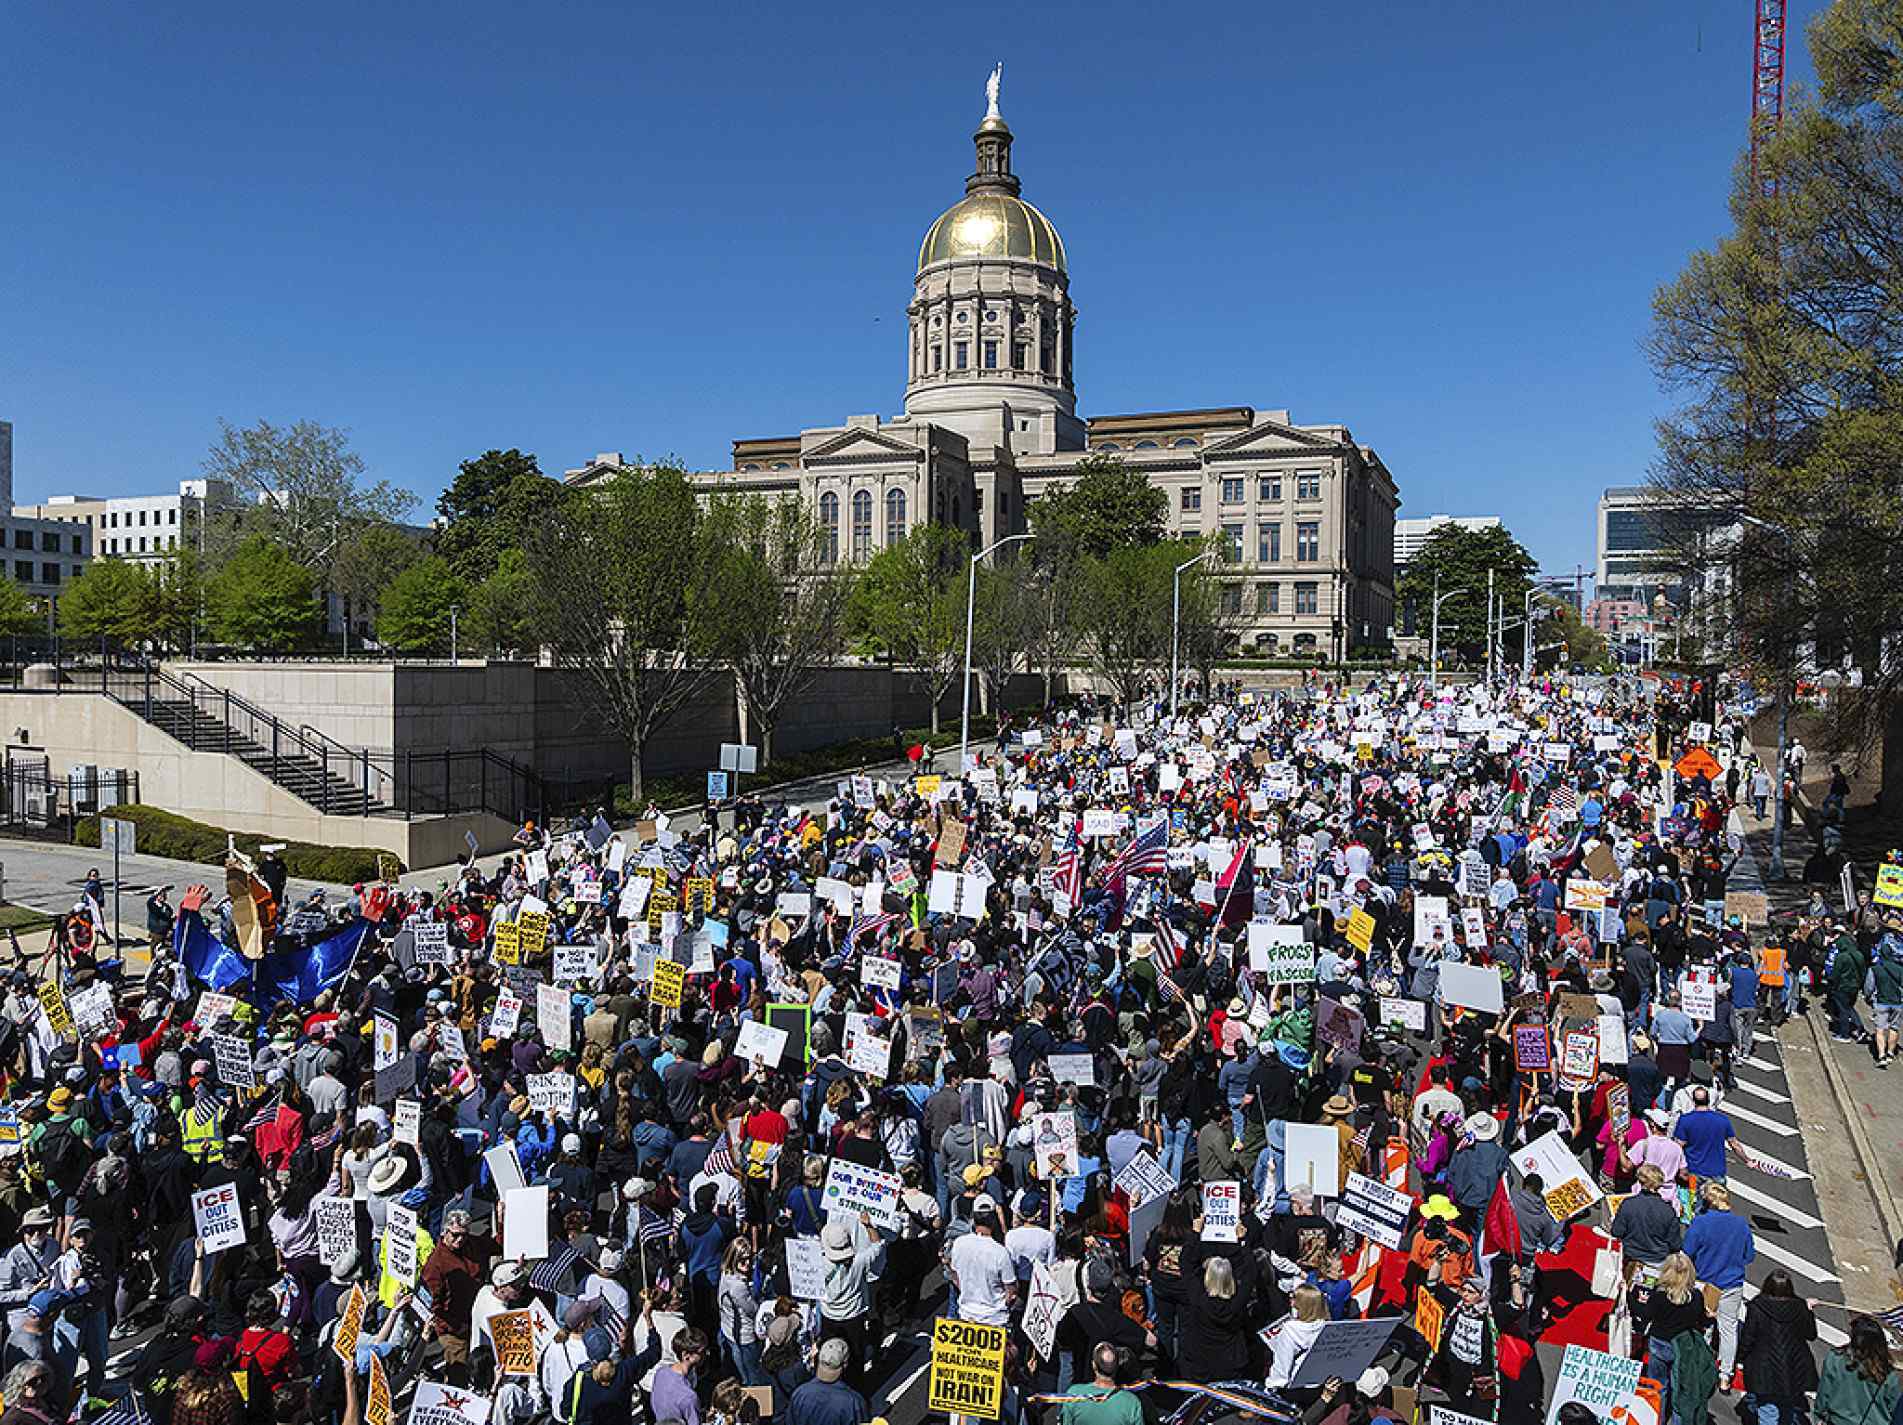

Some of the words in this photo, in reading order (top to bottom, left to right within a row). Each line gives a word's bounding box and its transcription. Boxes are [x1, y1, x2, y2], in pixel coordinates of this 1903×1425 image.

[1267, 944, 1313, 962] FROGS
[196, 1188, 233, 1209] ICE
[1206, 1186, 1237, 1199] ICE
[205, 1203, 228, 1219] OUT
[1209, 1198, 1230, 1208] OUT
[202, 1218, 239, 1238] CITIES
[1205, 1215, 1237, 1226] CITIES
[937, 1324, 1002, 1351] $200B
[505, 1353, 531, 1367] 1776
[936, 1352, 1000, 1373] HEALTHCARE
[1567, 1345, 1640, 1377] HEALTHCARE
[937, 1367, 956, 1379] NOT
[957, 1370, 980, 1382] WAR
[981, 1375, 996, 1386] ON
[1562, 1363, 1578, 1379] IS
[1579, 1368, 1590, 1382] A
[1592, 1370, 1637, 1393] HUMAN
[934, 1379, 993, 1405] IRAN!
[1574, 1382, 1620, 1407] RIGHT
